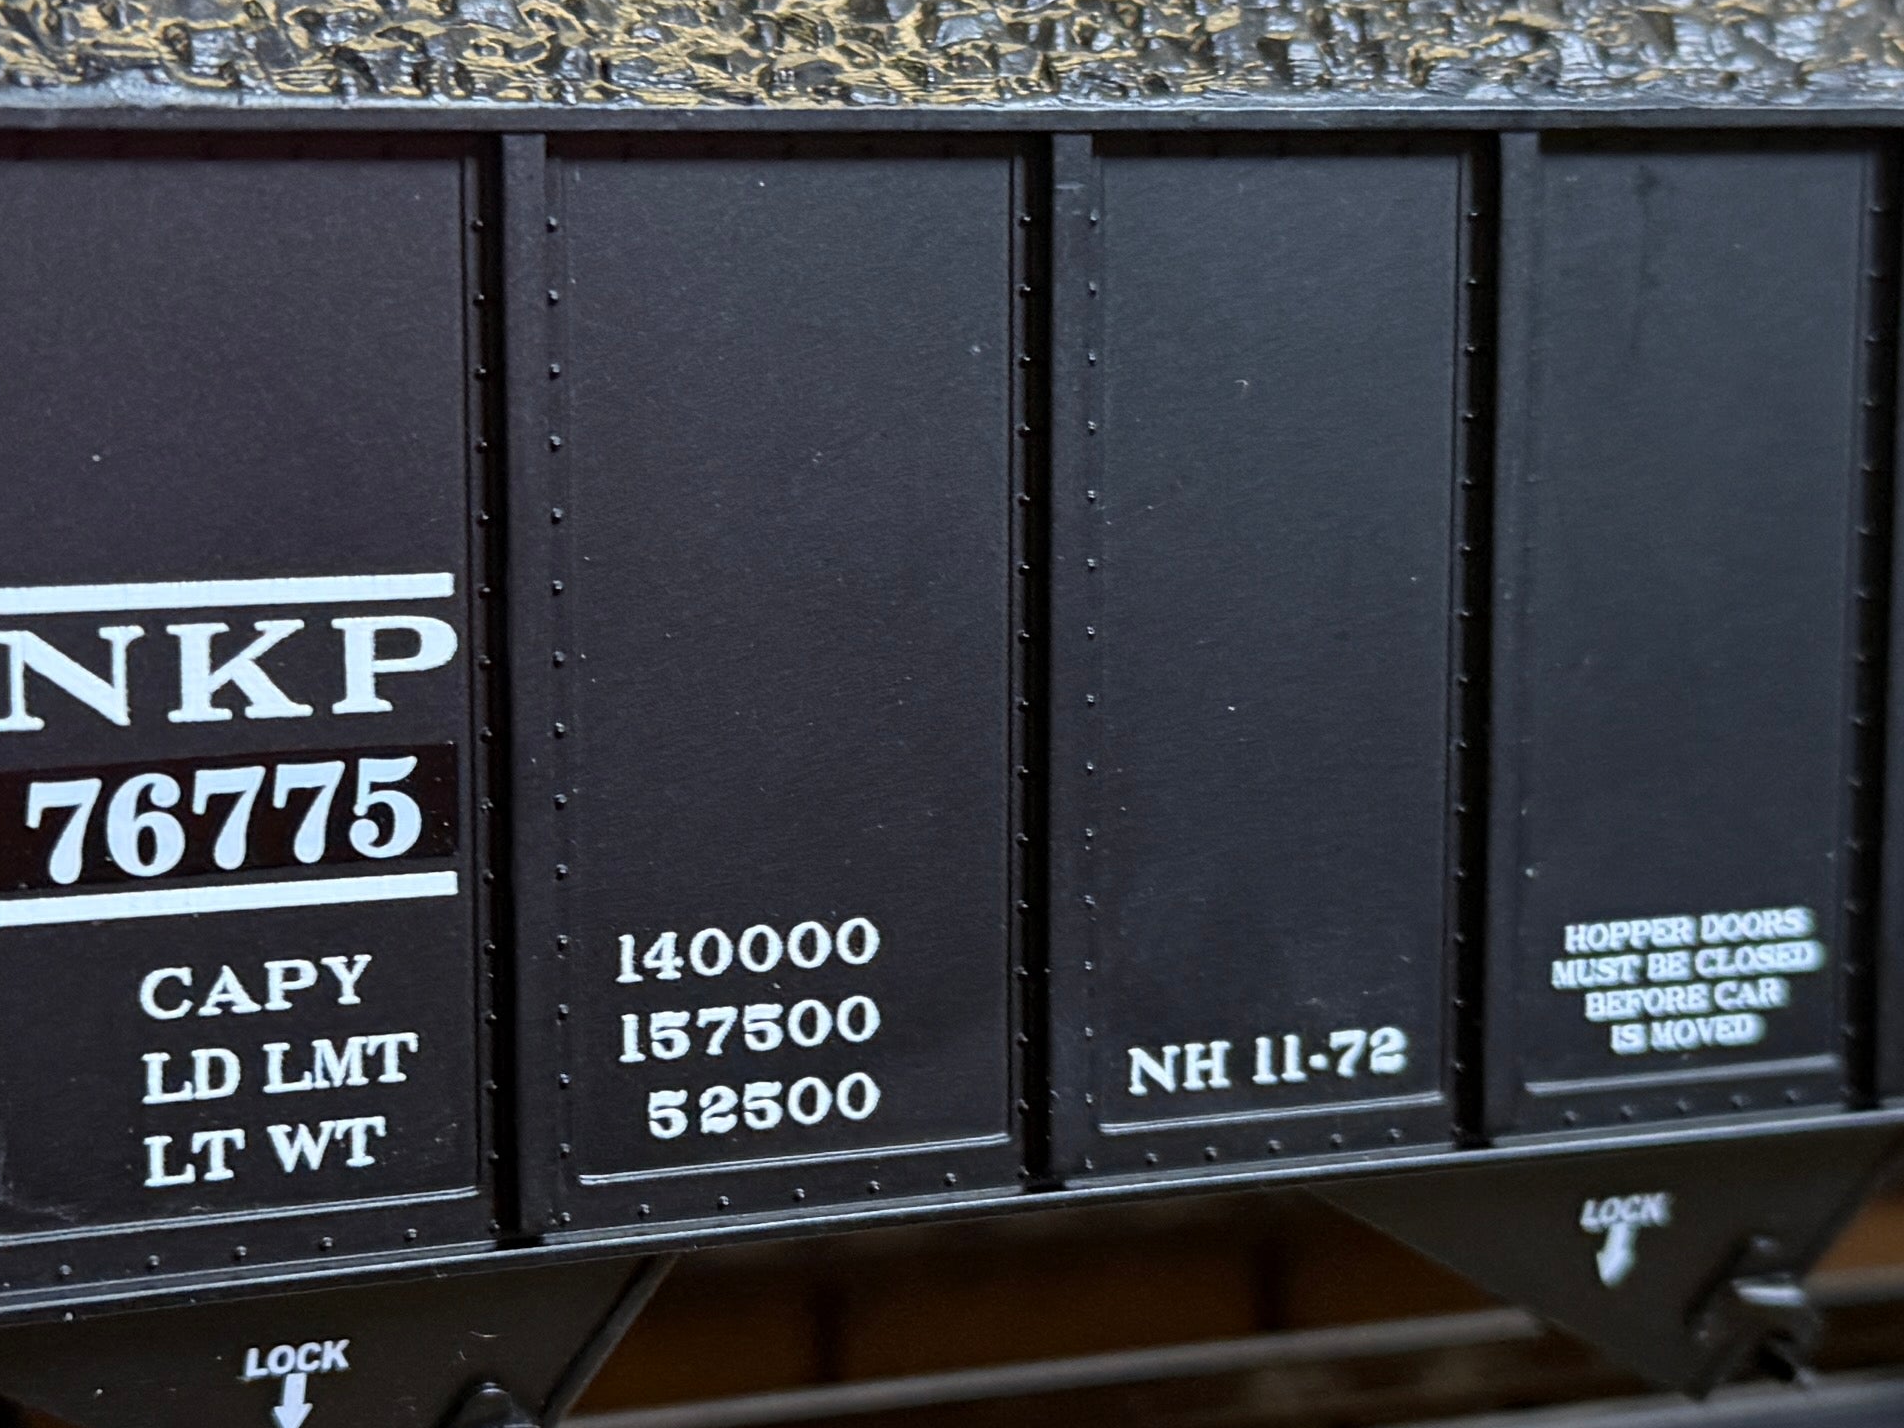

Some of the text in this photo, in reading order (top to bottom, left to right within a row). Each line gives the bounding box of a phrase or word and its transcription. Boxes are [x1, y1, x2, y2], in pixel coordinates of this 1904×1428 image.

[26, 756, 423, 885] 76775
[616, 917, 881, 984] 140000
[1565, 906, 1815, 954] HOPPER DOORS
[139, 954, 372, 1020] CAPY
[1552, 939, 1826, 989] MUST BE CLOSED
[618, 995, 881, 1063] 157500
[1585, 977, 1790, 1021] BEFORE CAR
[1611, 1013, 1765, 1054] IS MOVED
[142, 1033, 419, 1104] LD LMT
[1128, 1040, 1232, 1096] NH
[648, 1072, 881, 1140] 52500
[143, 1116, 387, 1188] LT WT
[1580, 1191, 1672, 1233] LOCK
[241, 1339, 352, 1382] LOCK
